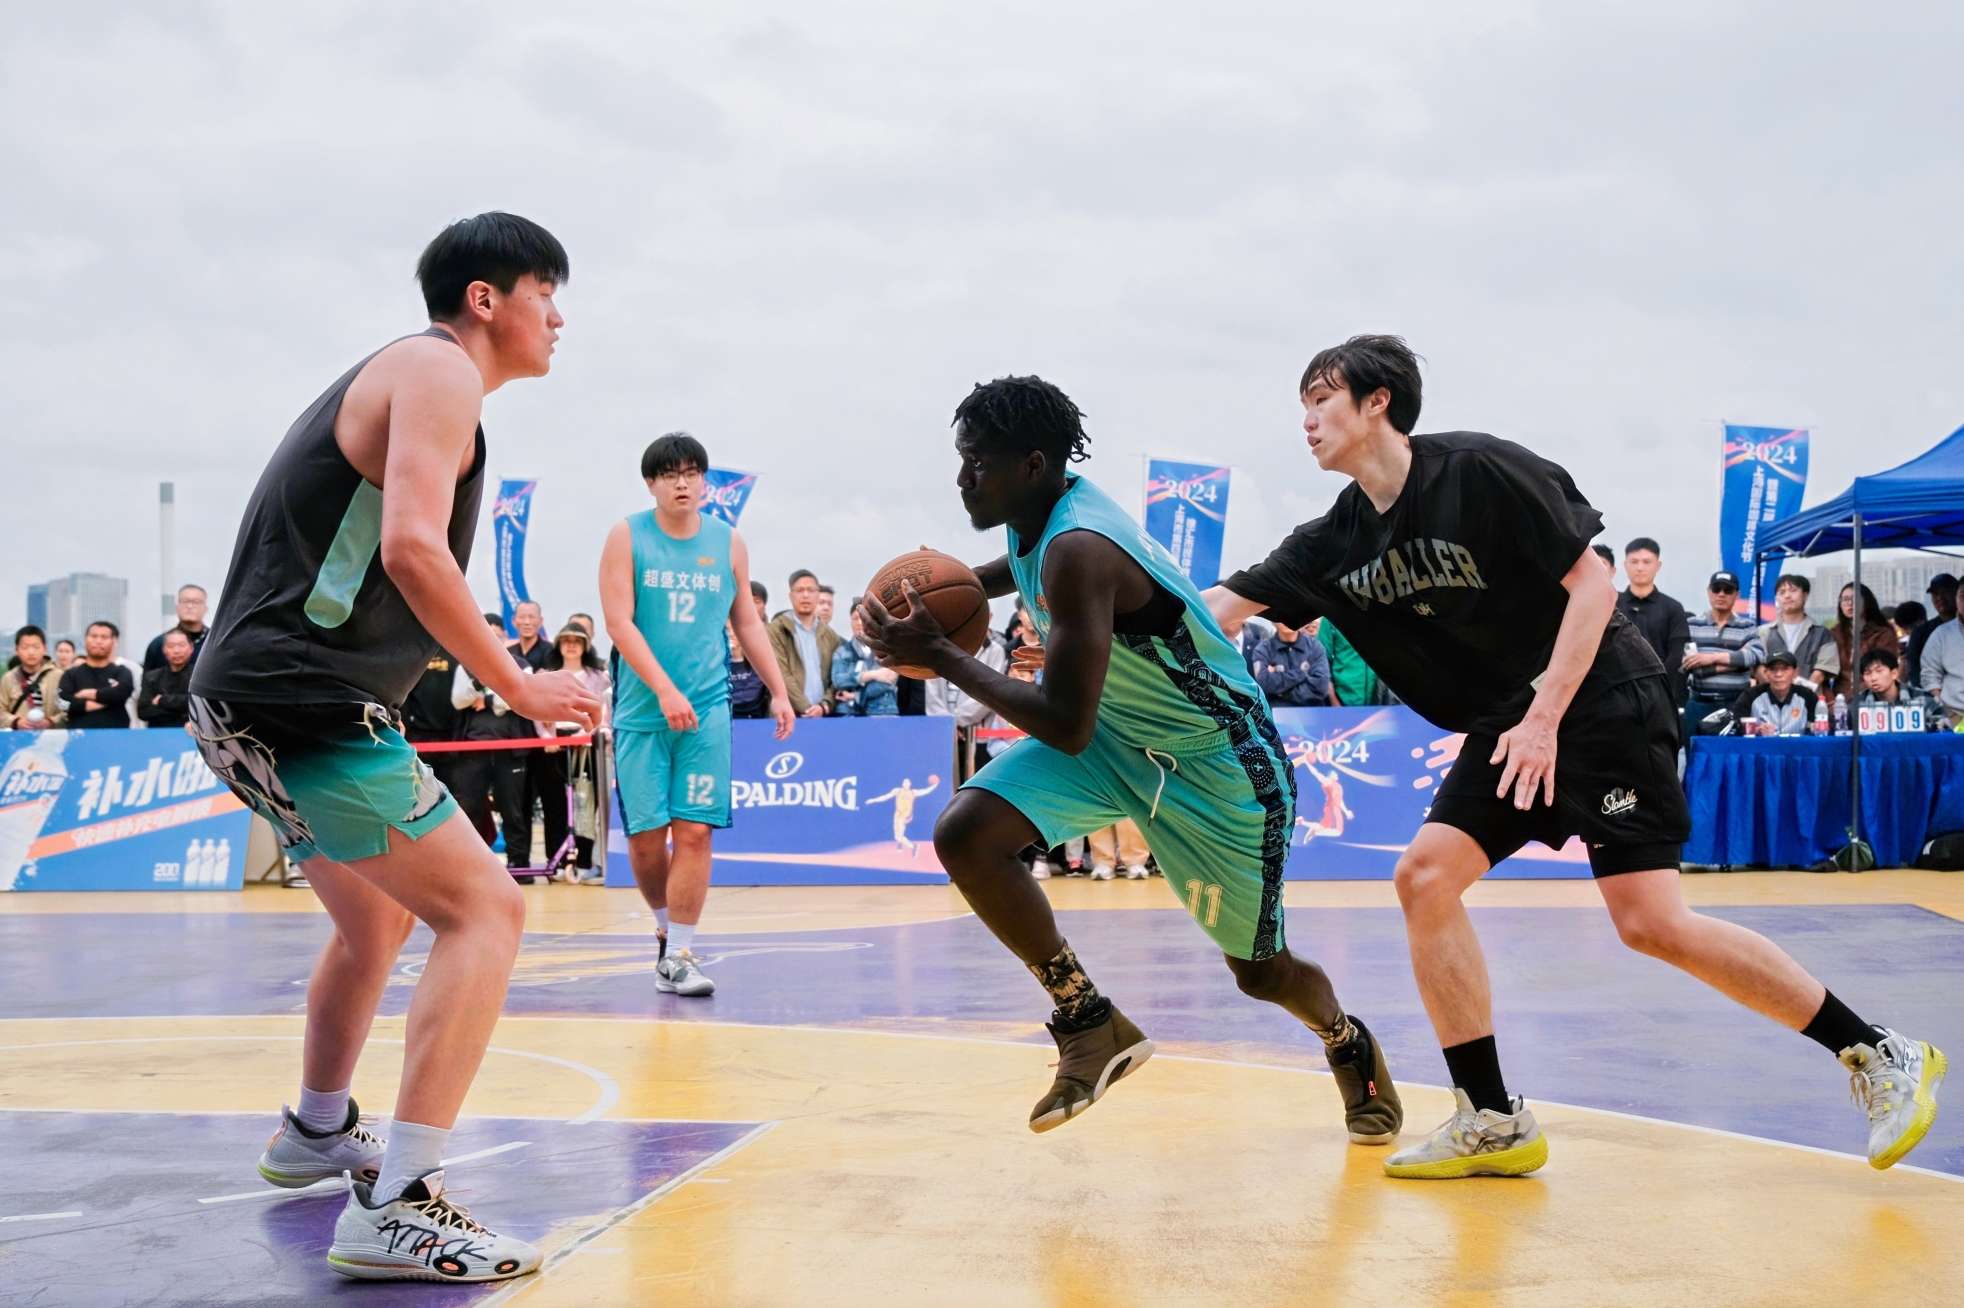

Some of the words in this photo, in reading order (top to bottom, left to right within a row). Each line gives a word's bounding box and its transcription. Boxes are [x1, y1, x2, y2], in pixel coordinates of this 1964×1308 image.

[1743, 442, 1797, 464] 2024
[1165, 480, 1218, 503] 2024
[668, 591, 696, 623] 12
[1299, 739, 1370, 765] 2024
[686, 773, 715, 806] 12
[731, 775, 858, 811] PALDING
[1186, 878, 1223, 928] 11
[377, 1216, 489, 1268] ATTACK
